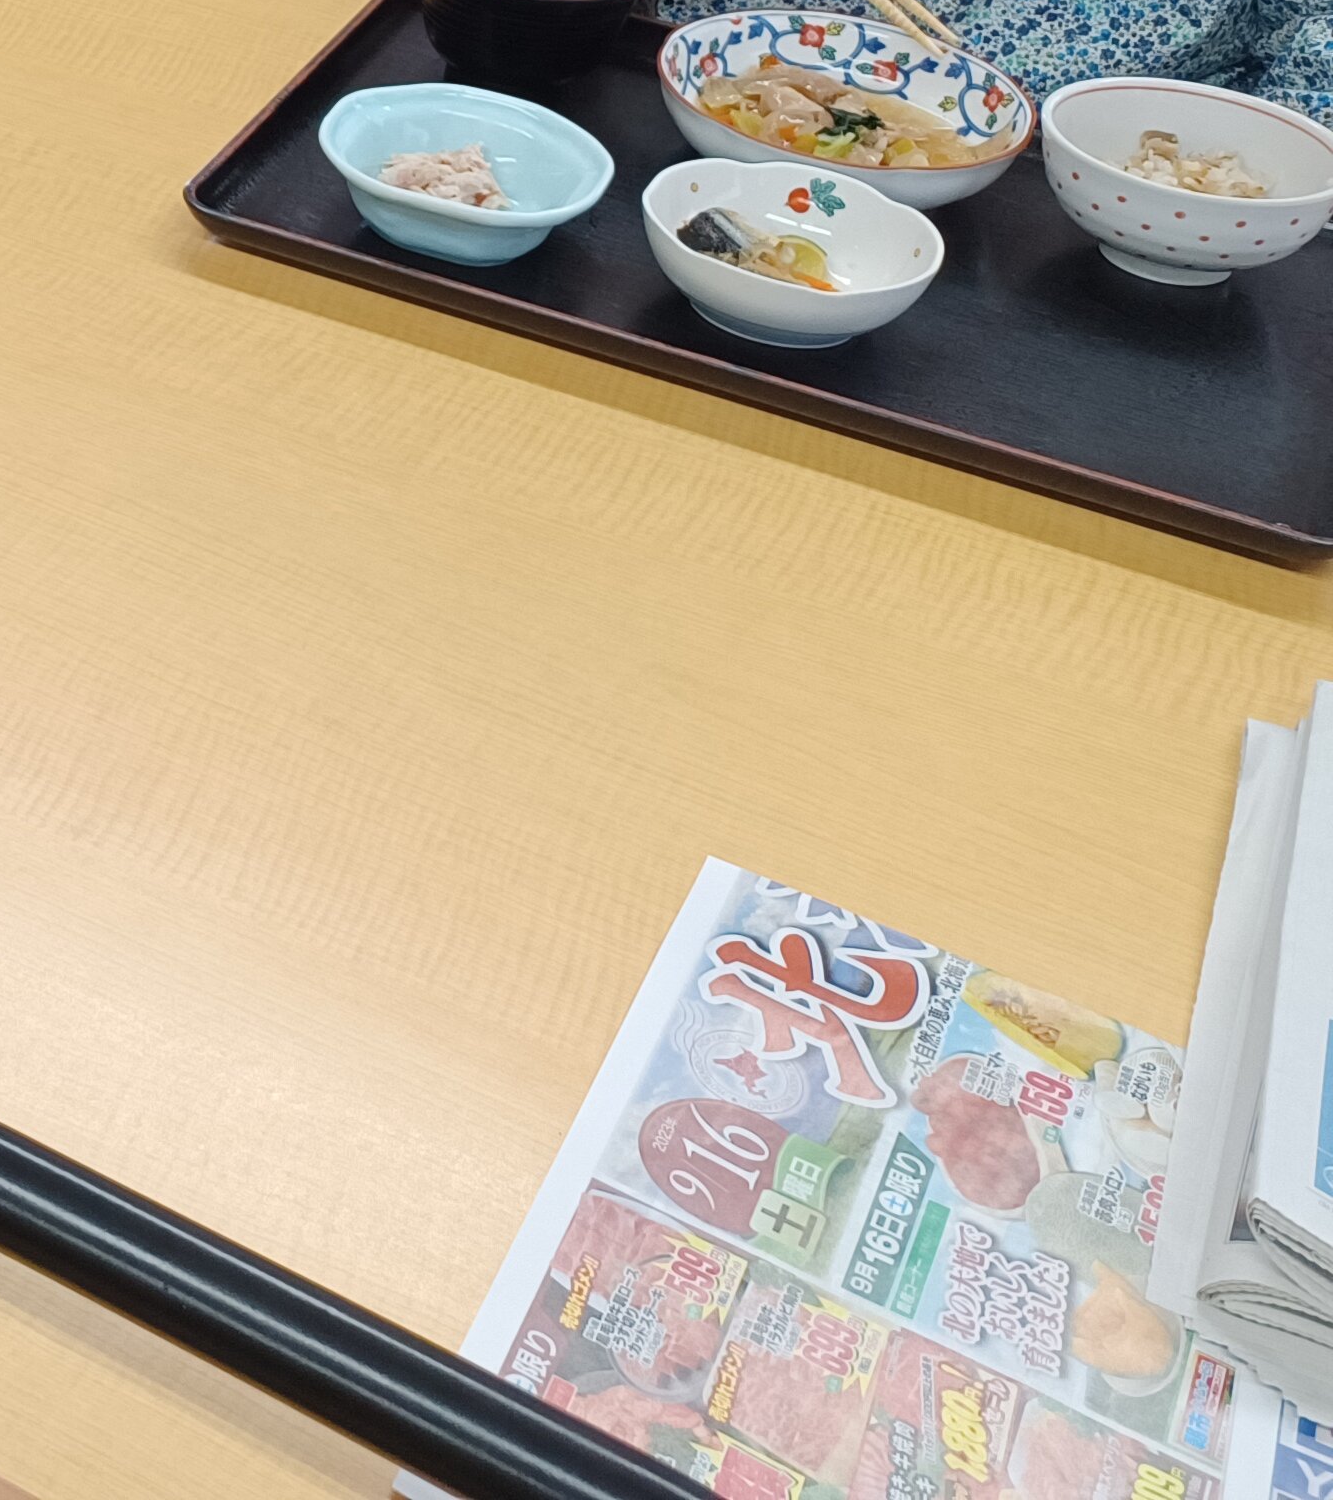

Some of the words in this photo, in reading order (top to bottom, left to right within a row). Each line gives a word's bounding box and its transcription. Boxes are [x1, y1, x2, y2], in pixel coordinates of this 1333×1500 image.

[707, 932, 921, 1102] 北
[977, 1051, 1005, 1099] ミニトマト
[1131, 1062, 1156, 1104] ながいも
[944, 1226, 992, 1341] 北の大地で
[984, 1255, 1029, 1339] おいしく
